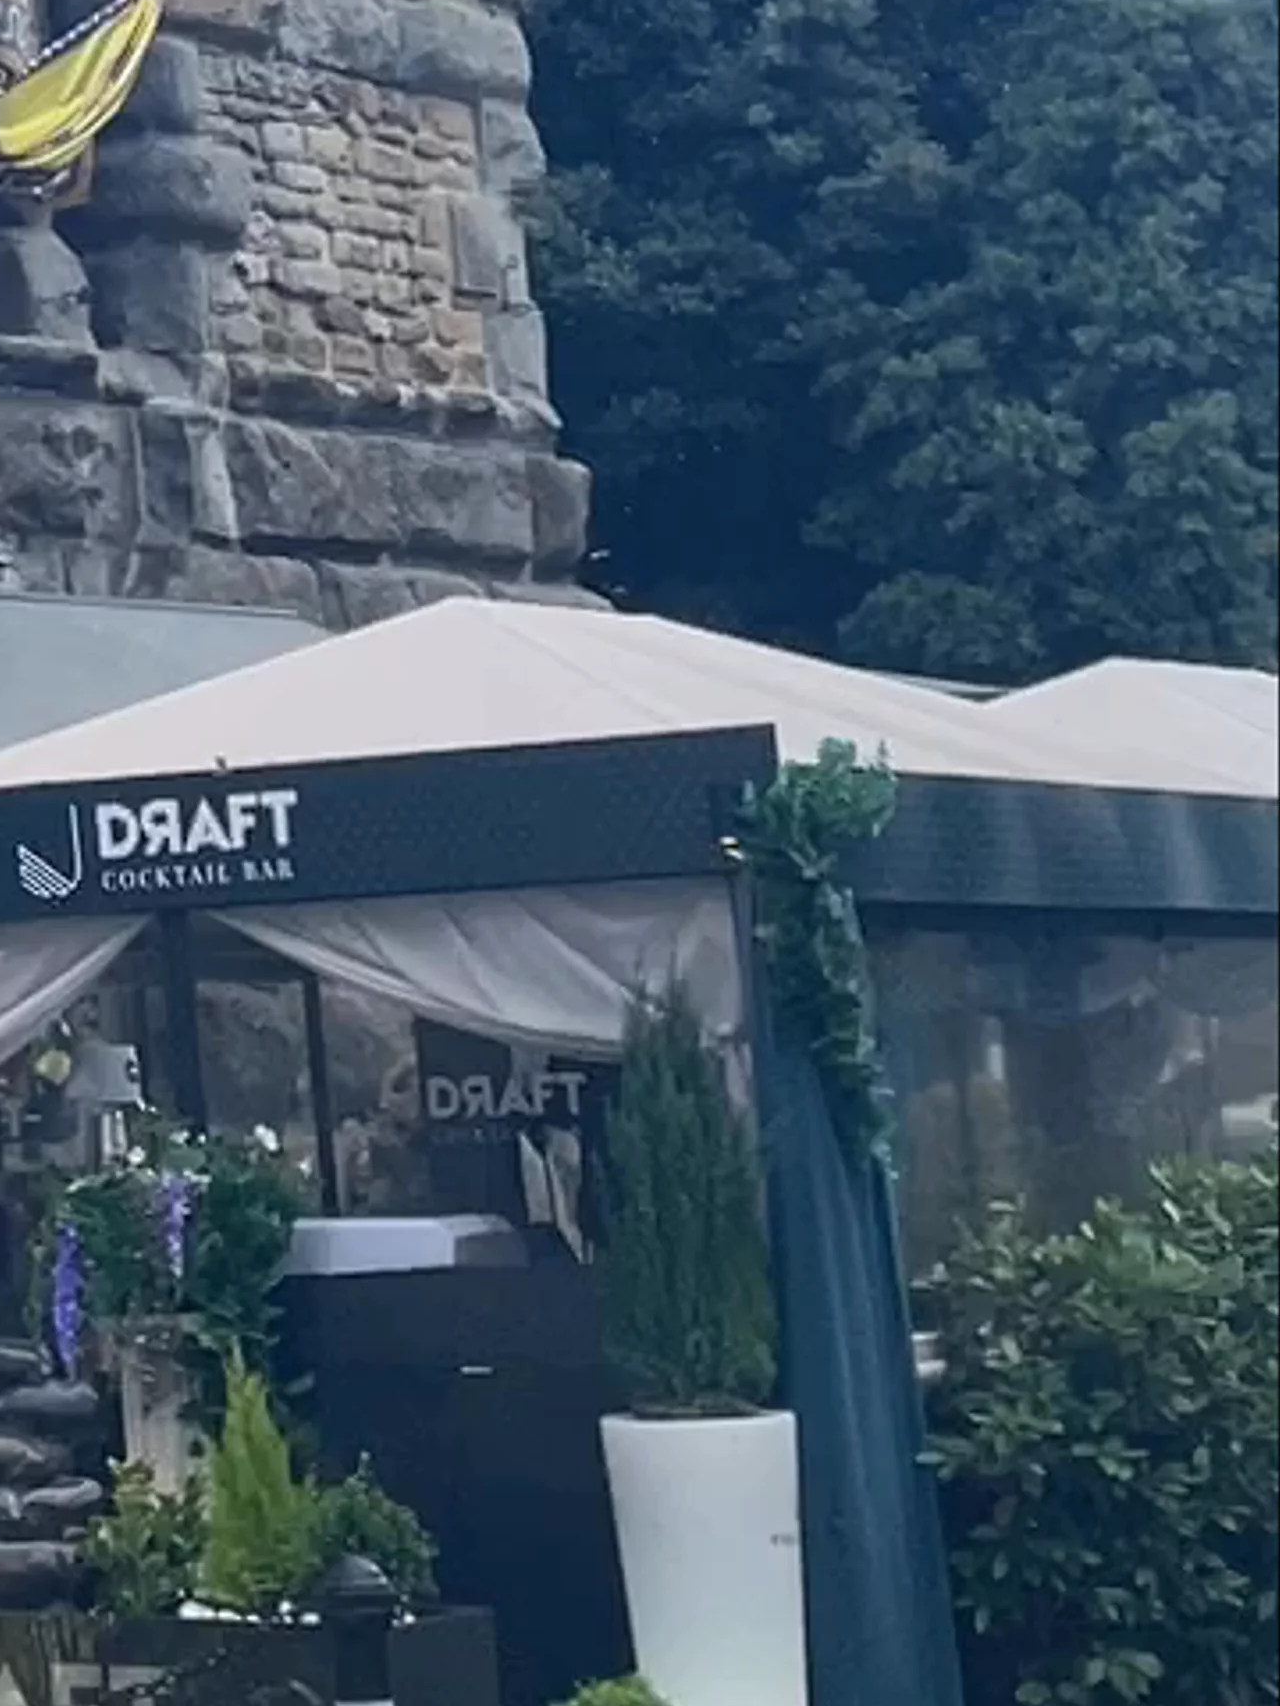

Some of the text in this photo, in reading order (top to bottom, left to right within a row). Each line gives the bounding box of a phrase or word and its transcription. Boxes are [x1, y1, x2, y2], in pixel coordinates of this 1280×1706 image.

[95, 790, 298, 861] DRAFT
[100, 857, 295, 892] COCKTAIL BAR
[425, 1071, 588, 1119] DRAFT
